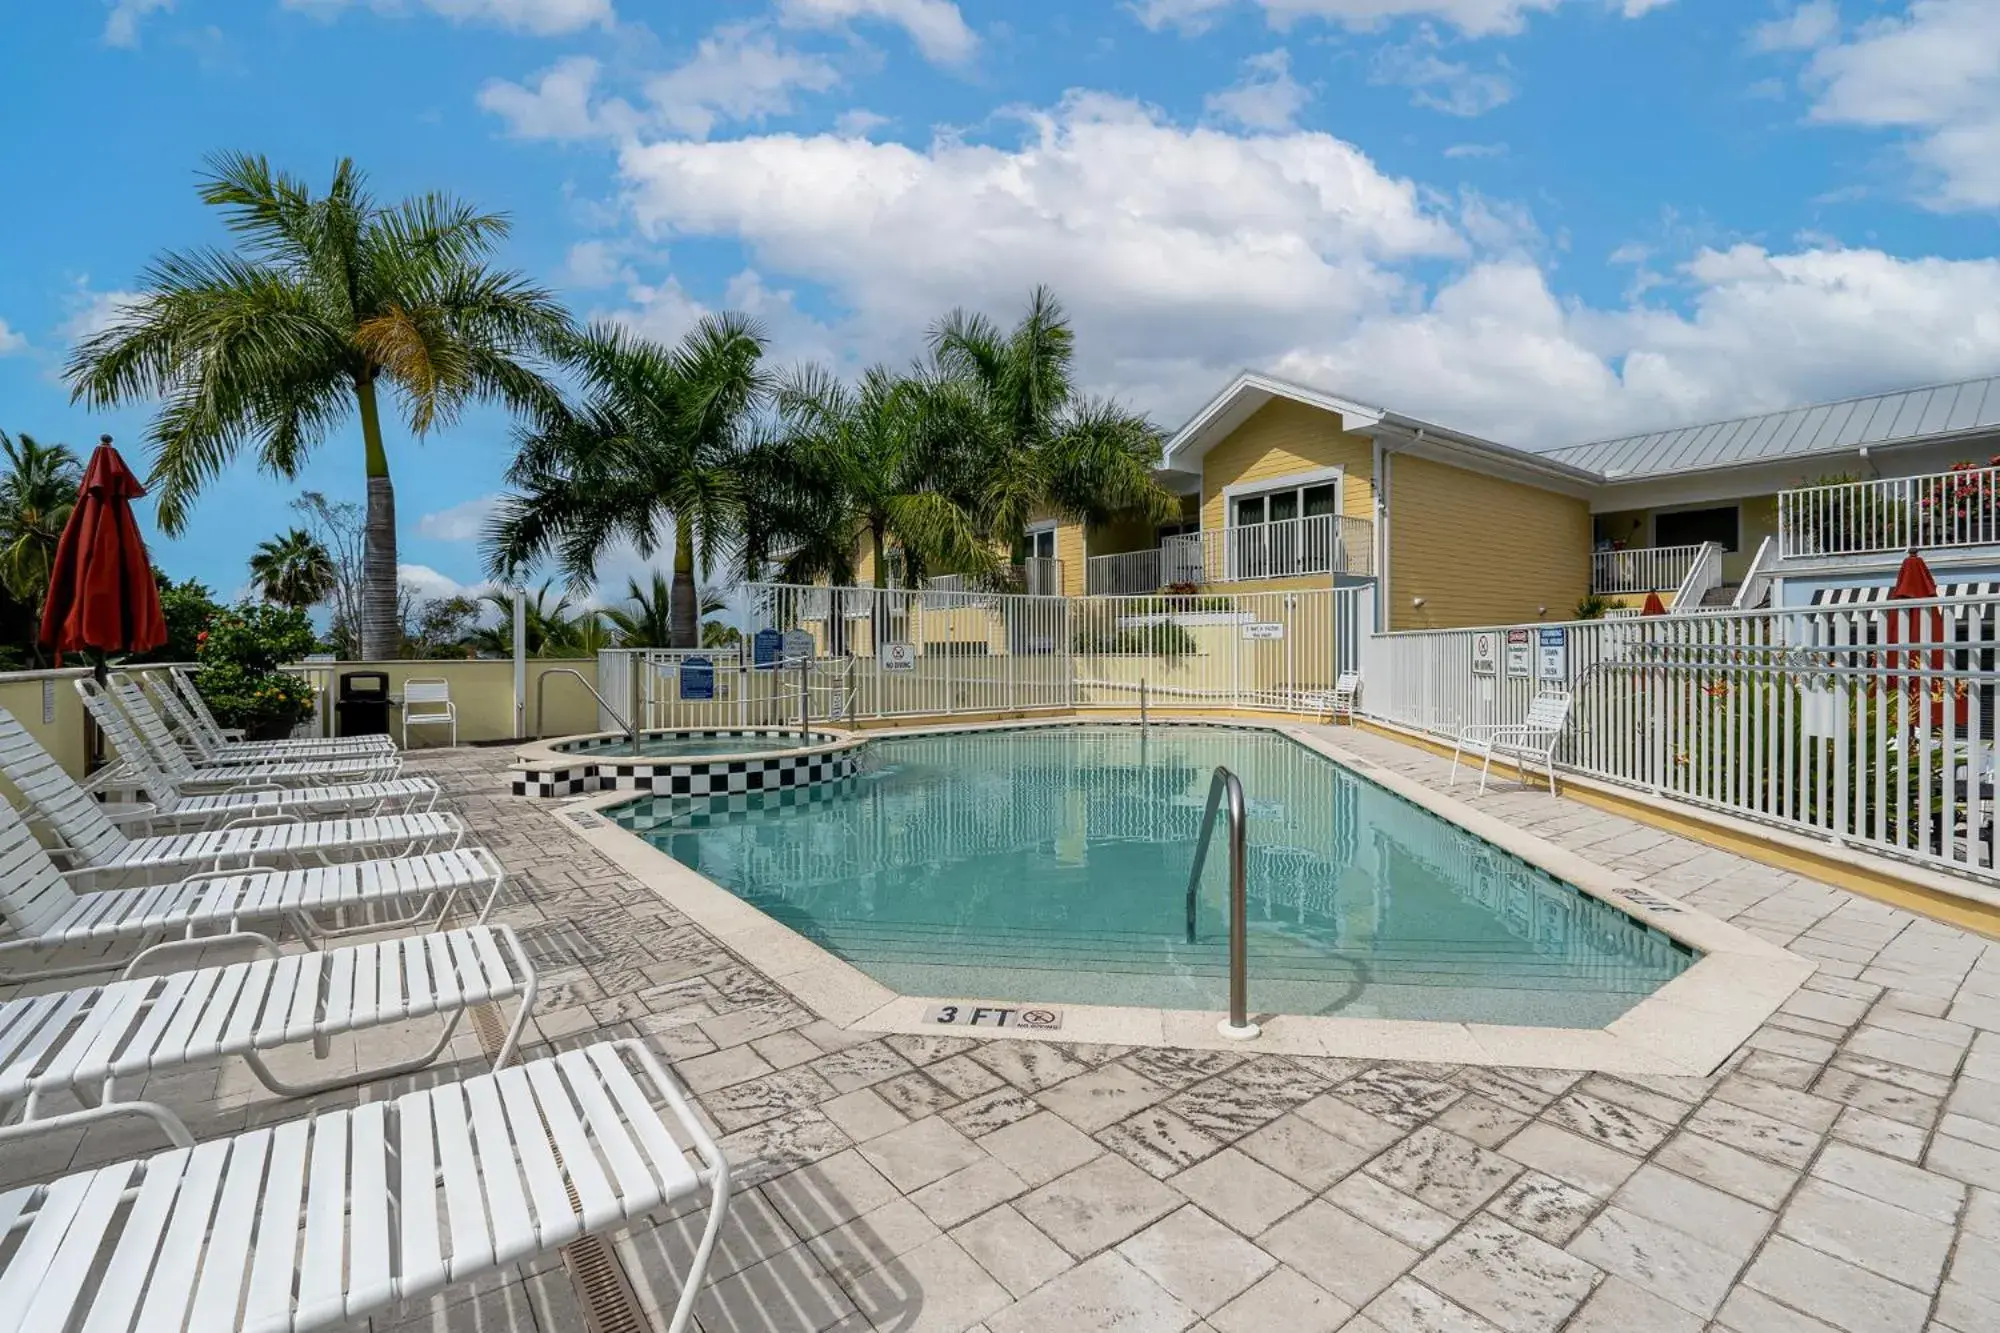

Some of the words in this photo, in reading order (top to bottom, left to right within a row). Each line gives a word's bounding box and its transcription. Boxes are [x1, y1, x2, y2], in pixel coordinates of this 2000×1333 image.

[886, 661, 894, 669] NO
[895, 661, 911, 669] DIVING
[936, 1005, 959, 1024] 3
[970, 1007, 1016, 1028] FT
[1030, 1023, 1058, 1031] DIVING
